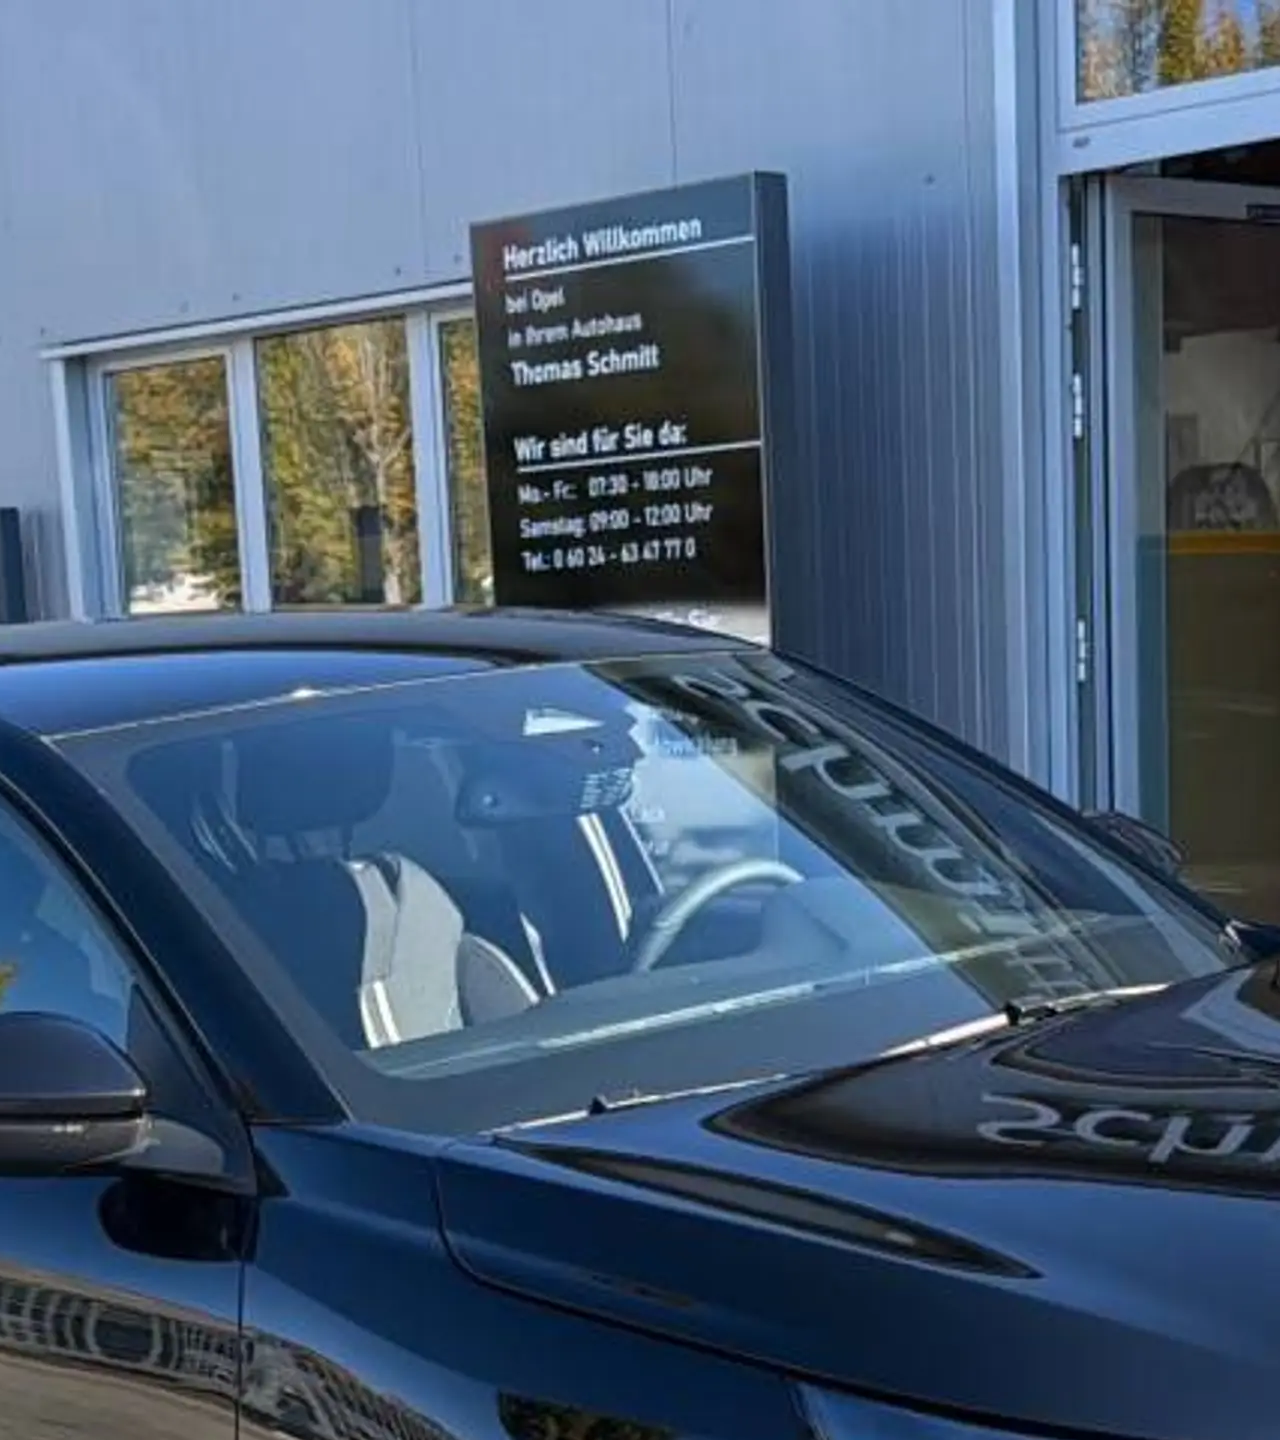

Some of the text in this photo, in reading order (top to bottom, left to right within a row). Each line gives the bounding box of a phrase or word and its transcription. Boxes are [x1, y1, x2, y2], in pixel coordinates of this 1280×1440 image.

[504, 218, 703, 271] Herzlich Willkommen
[505, 286, 566, 315] bei Opel
[525, 323, 569, 347] Ihrem
[571, 311, 643, 340] Autohaus
[510, 341, 660, 387] Thomas Schmitt
[513, 419, 688, 463] Wir sind für Sie da:
[684, 466, 714, 489] Uhr
[589, 508, 630, 533] 09:00
[643, 502, 681, 527] 12:00
[684, 501, 714, 524] Uhr
